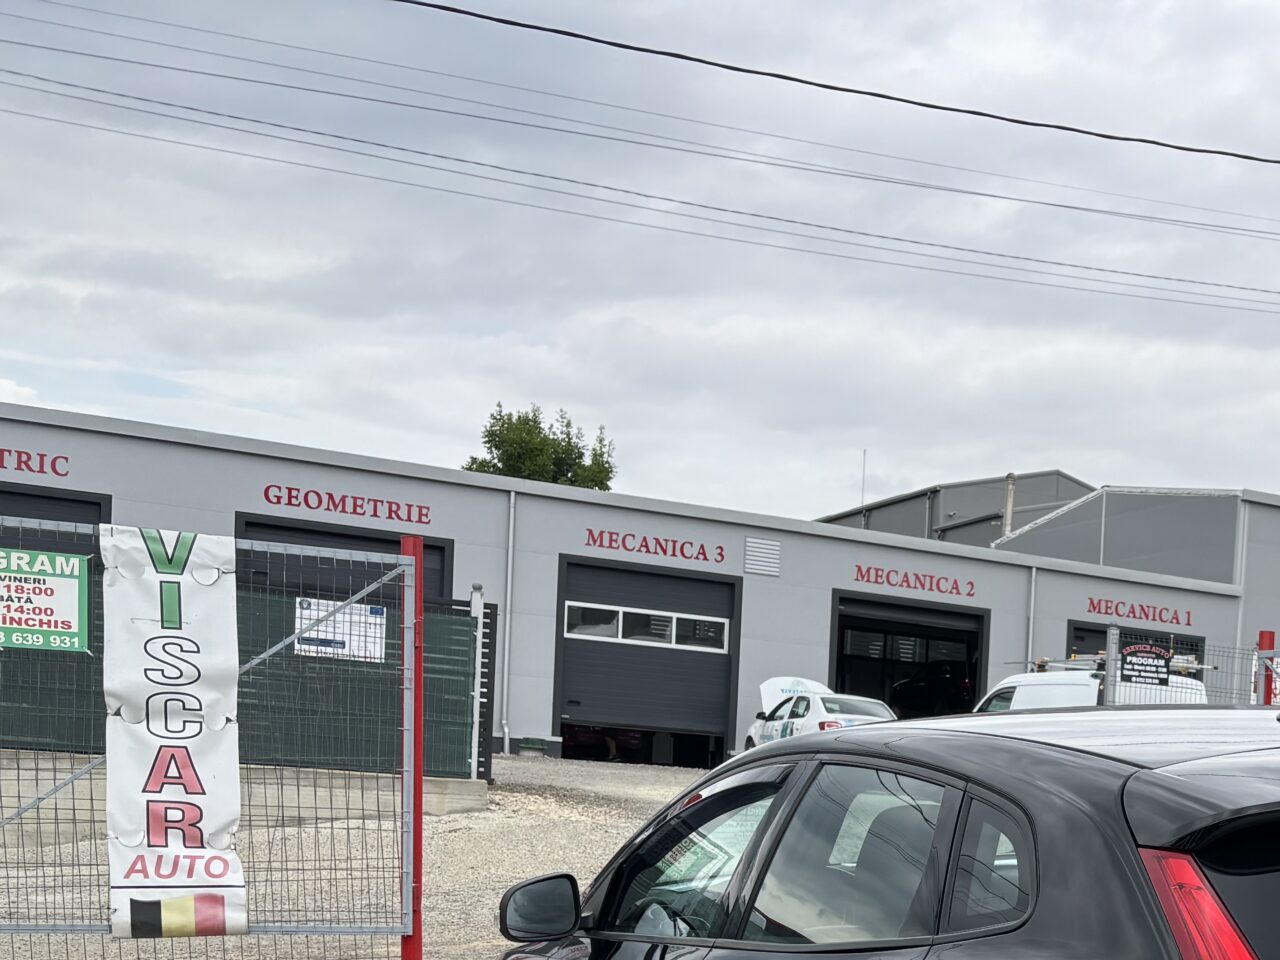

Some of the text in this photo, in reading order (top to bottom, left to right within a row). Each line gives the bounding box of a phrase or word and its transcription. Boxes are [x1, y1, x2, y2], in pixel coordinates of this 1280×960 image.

[263, 484, 432, 525] GEOMETRIE
[584, 528, 725, 564] MECANICA 3
[3, 584, 54, 597] 18:00
[854, 565, 976, 597] MECANICA 2
[1, 613, 73, 630] ÎNCHIS
[3, 604, 54, 617] 14:00
[1087, 597, 1192, 627] MECANICA 1
[12, 632, 44, 646] 639
[49, 635, 79, 649] 931
[1126, 656, 1166, 667] PROGRAM
[139, 527, 207, 849] VISCAR
[123, 853, 230, 880] AUTO
